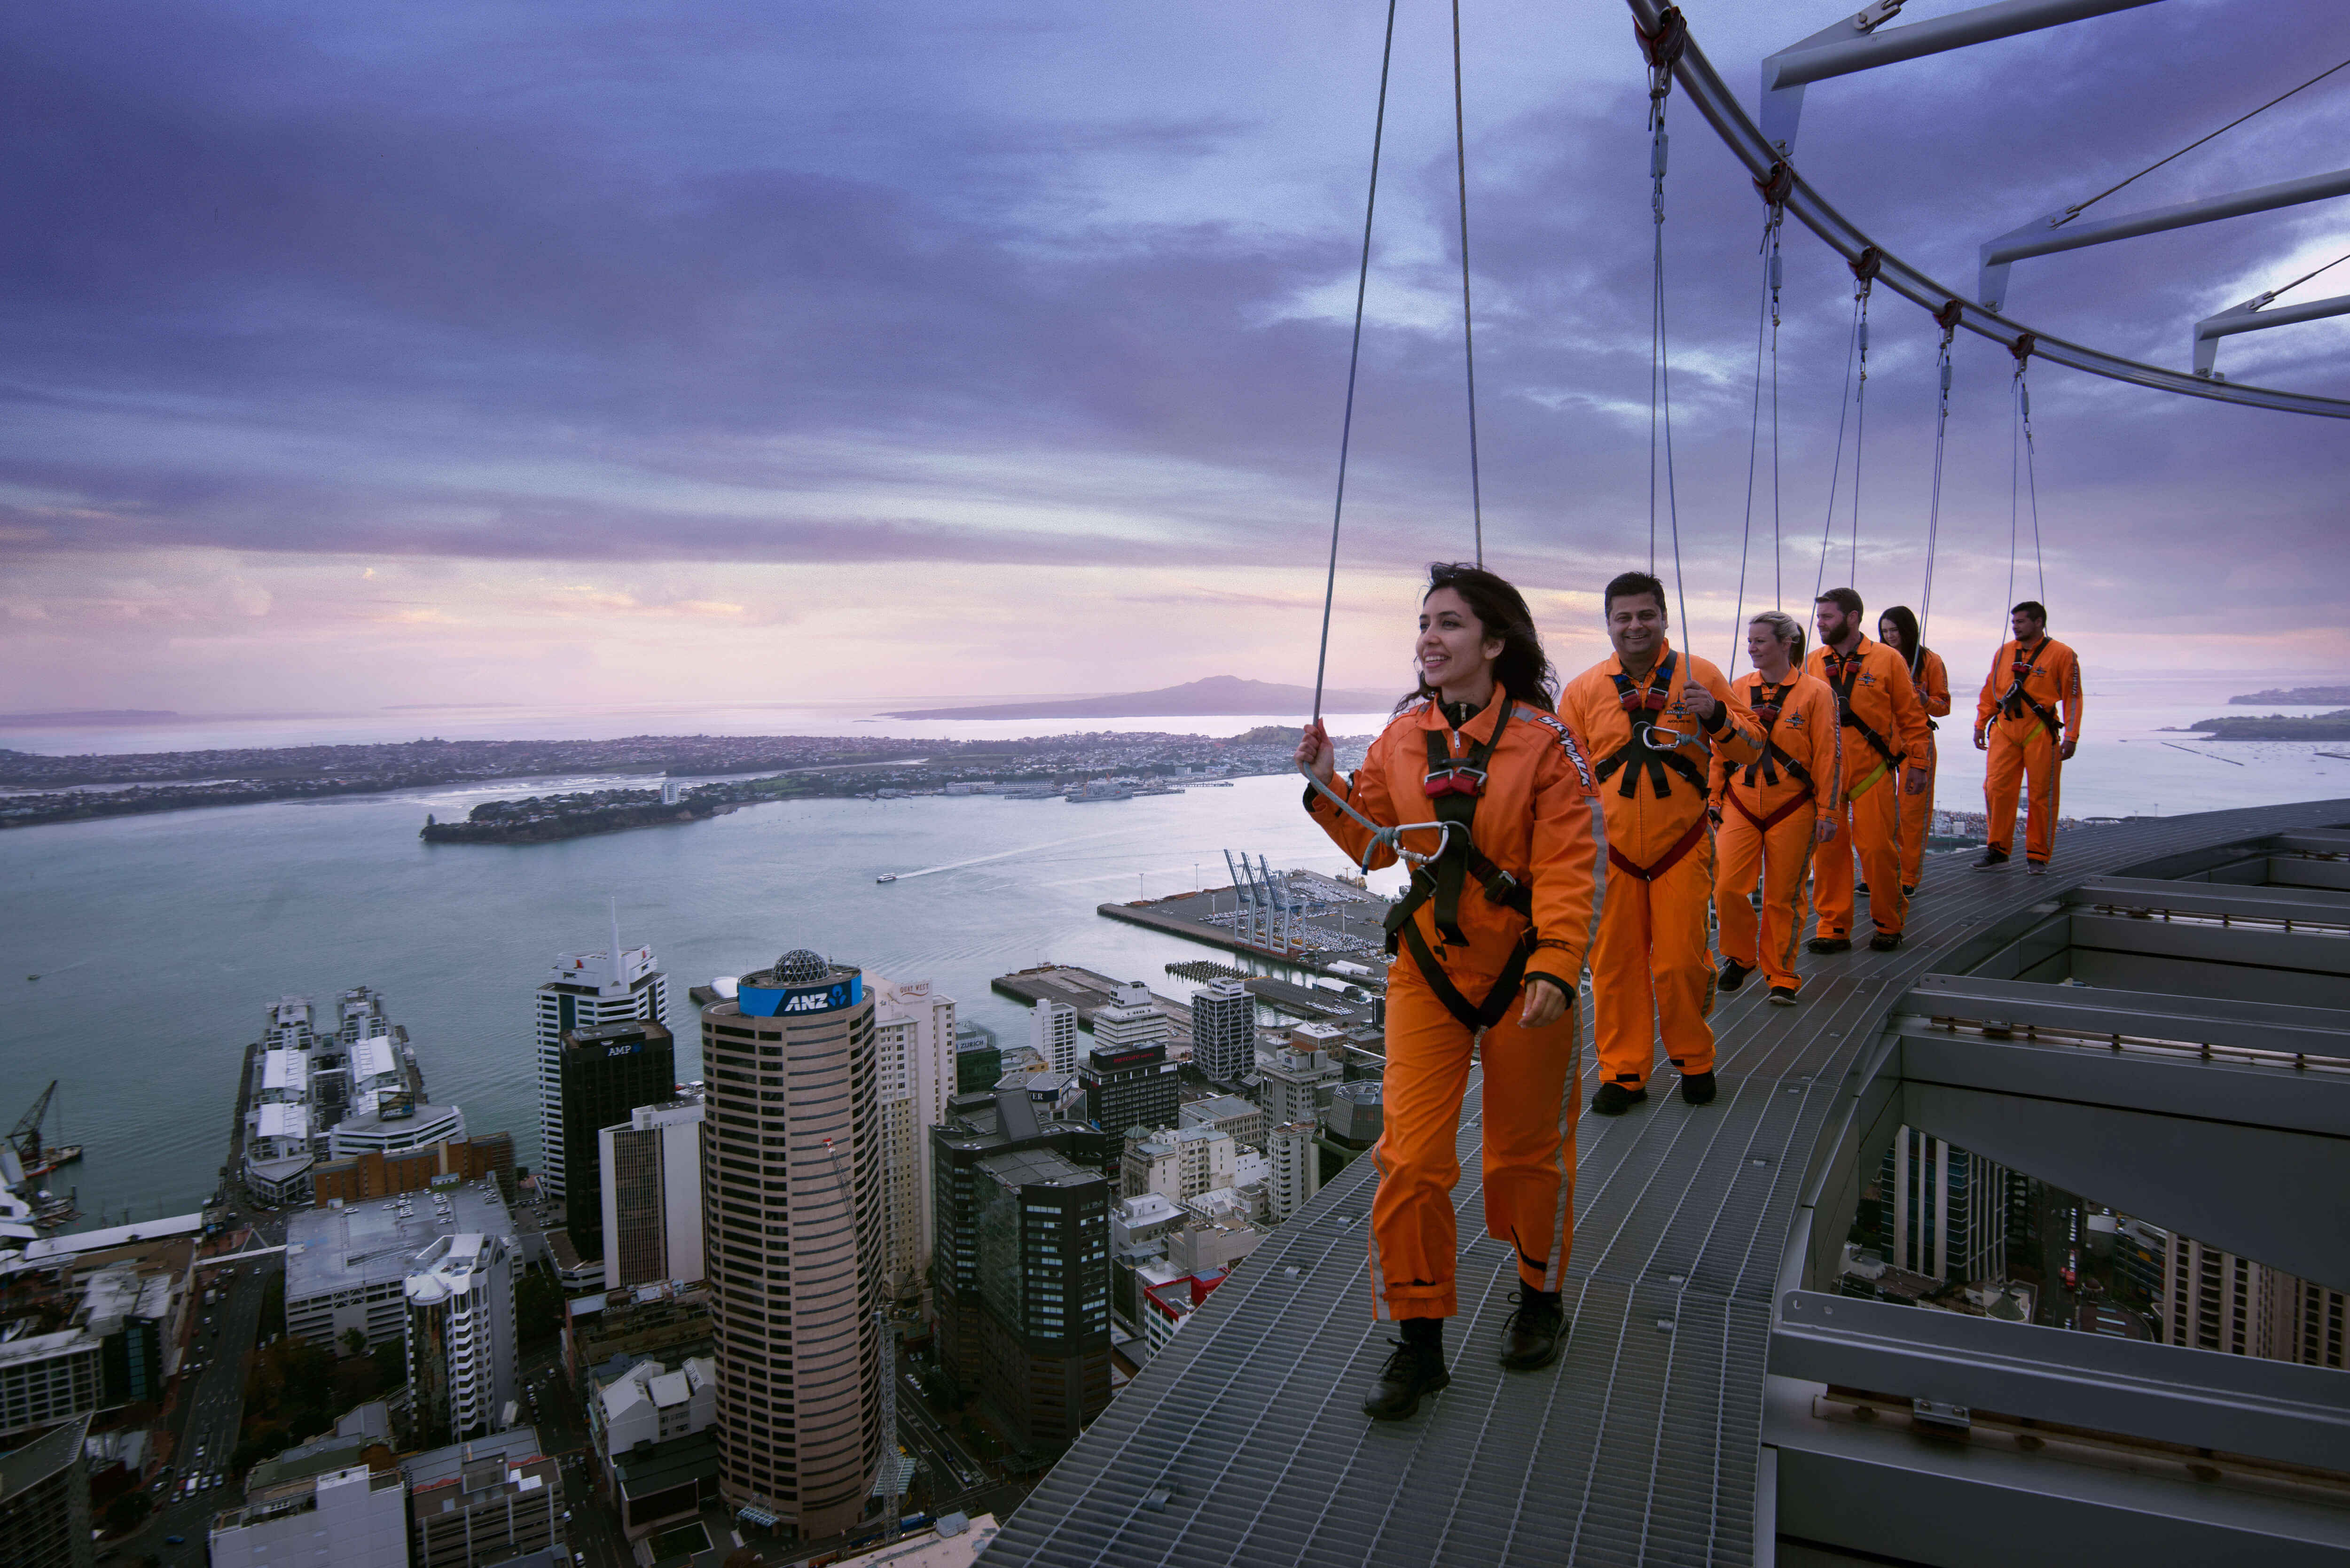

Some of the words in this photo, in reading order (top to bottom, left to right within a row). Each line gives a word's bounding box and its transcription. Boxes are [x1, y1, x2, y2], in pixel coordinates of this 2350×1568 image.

[1535, 716, 1592, 792] SKYWALK
[784, 992, 828, 1011] ANZ
[608, 1045, 631, 1056] AMP
[960, 1040, 984, 1049] ZURICH
